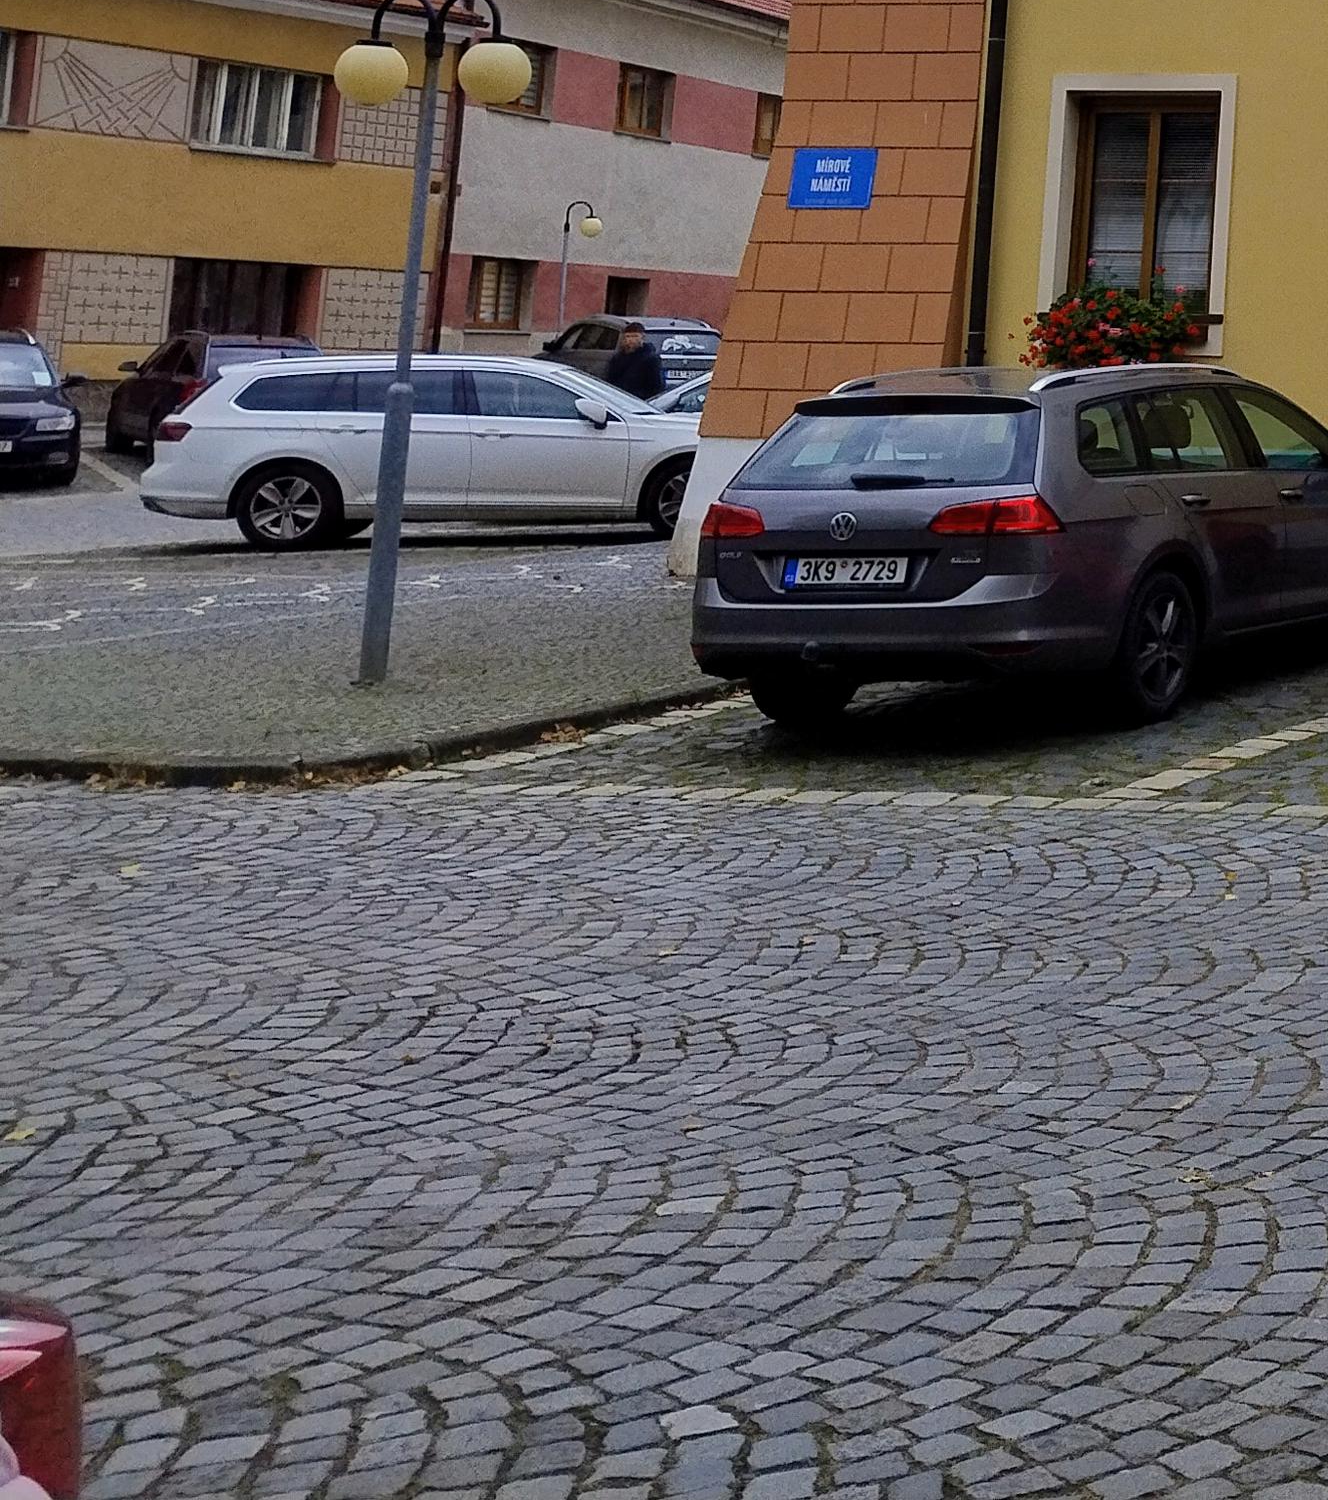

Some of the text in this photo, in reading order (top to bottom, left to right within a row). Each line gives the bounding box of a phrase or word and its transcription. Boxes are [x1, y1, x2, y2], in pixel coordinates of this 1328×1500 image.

[815, 156, 852, 173] MÍROVÉ
[810, 176, 852, 192] NÁMĚSTÍ
[800, 560, 898, 582] 3K9 2729
